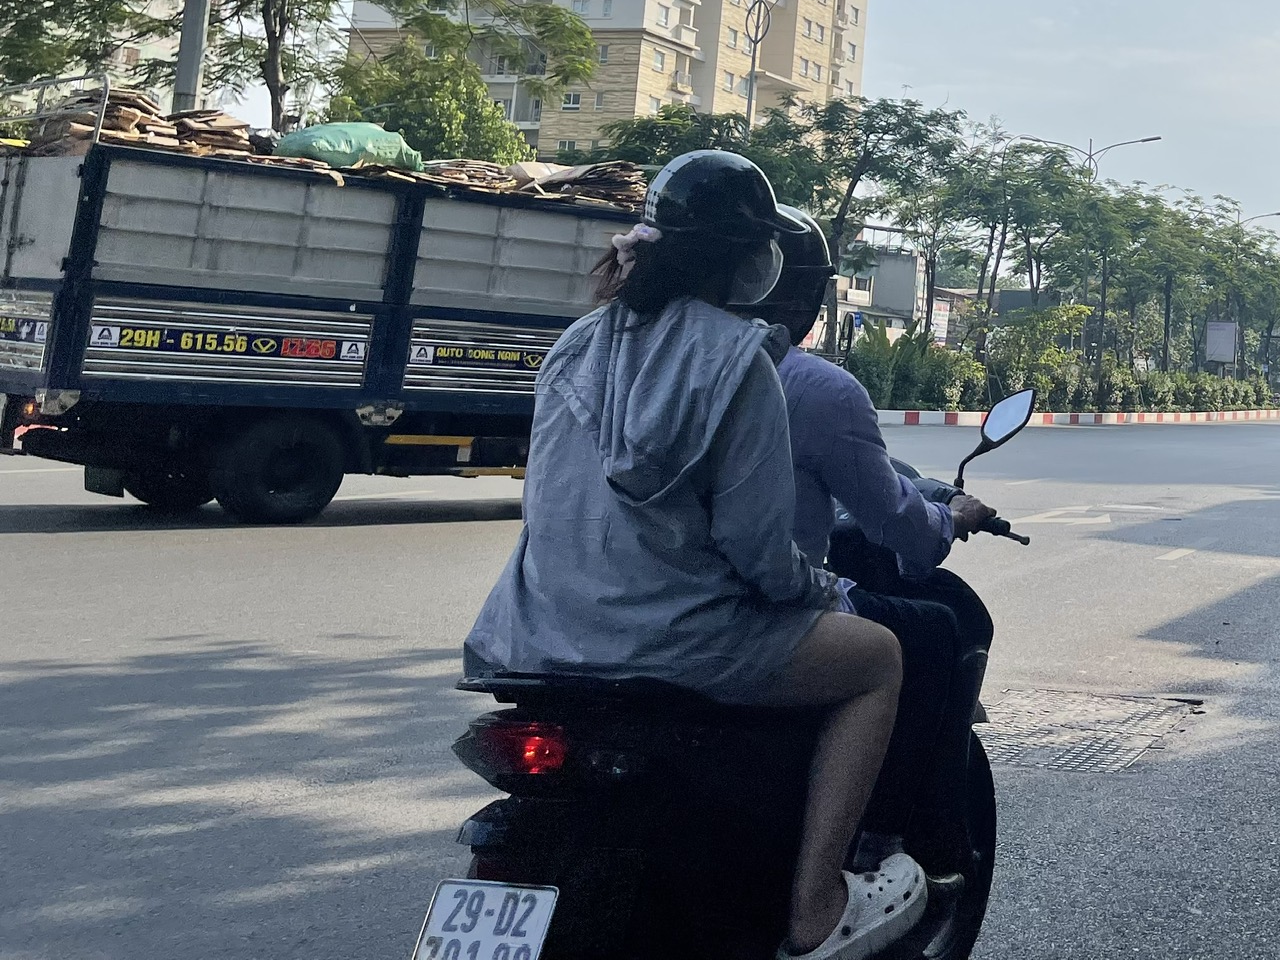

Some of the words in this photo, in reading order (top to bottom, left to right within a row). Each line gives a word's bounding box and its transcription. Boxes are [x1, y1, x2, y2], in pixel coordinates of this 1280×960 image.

[119, 328, 161, 348] 29H
[180, 332, 248, 353] 615.56
[436, 346, 464, 358] AUTO
[497, 350, 521, 361] NAM
[441, 888, 538, 938] 29-D2
